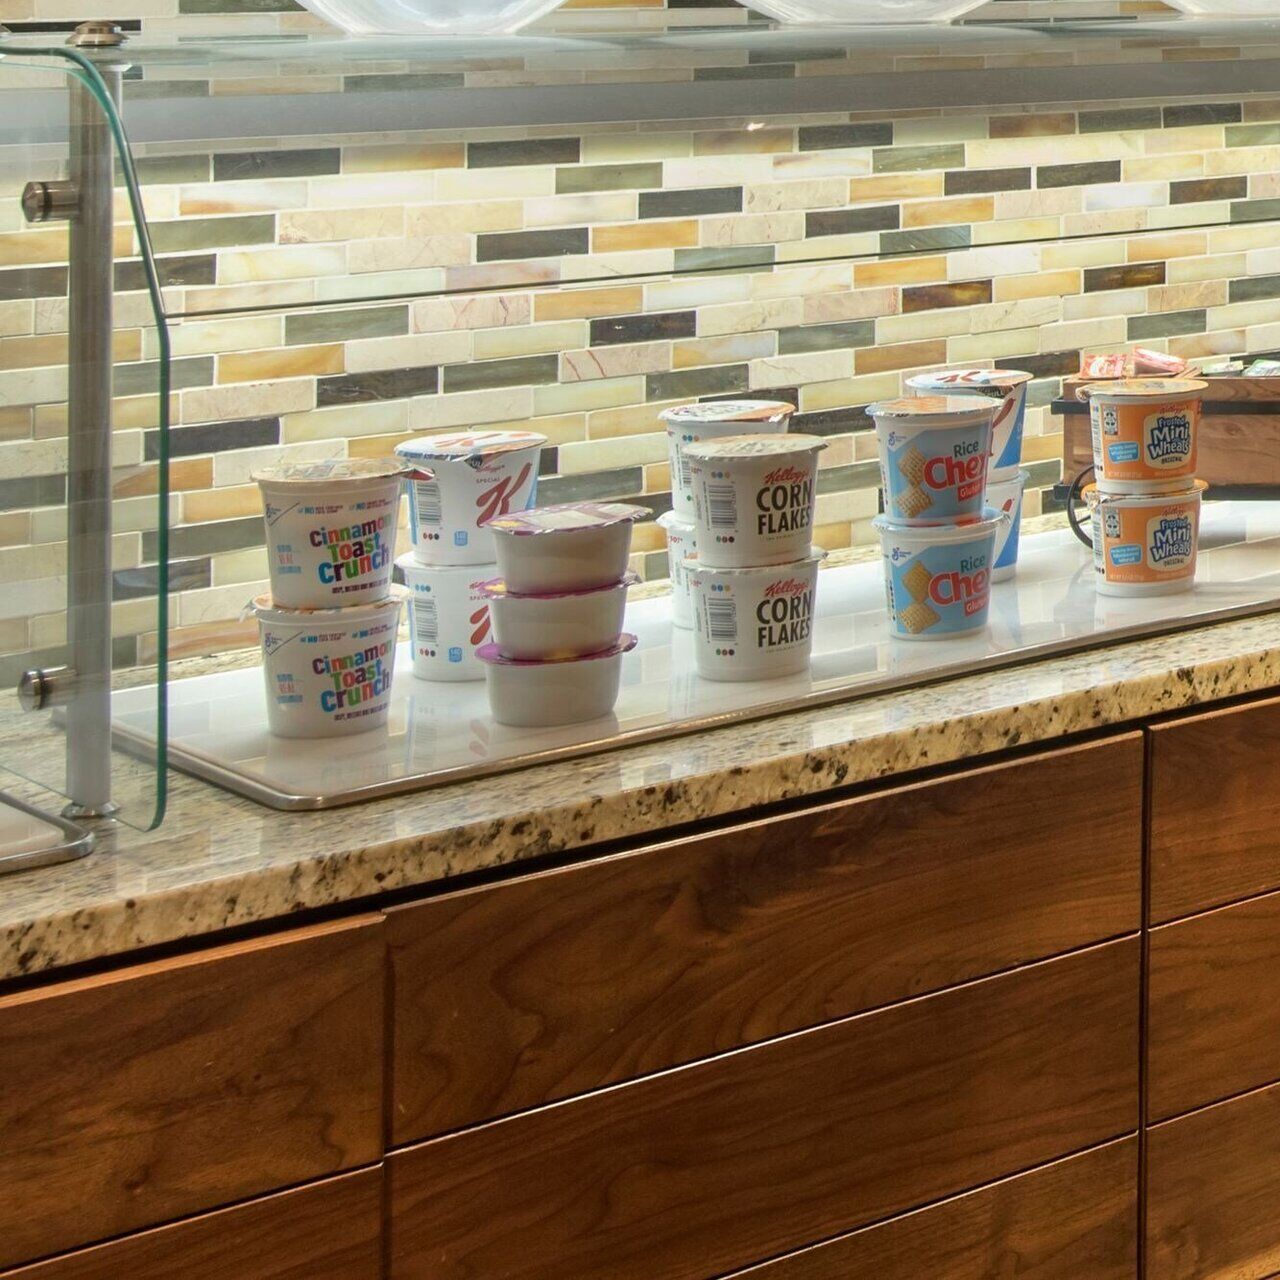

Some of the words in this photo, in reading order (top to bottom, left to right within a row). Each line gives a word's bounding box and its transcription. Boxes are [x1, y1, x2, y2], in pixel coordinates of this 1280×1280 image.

[953, 440, 979, 458] Rice
[1148, 440, 1190, 459] Wheats
[1152, 424, 1189, 445] Mini
[756, 478, 812, 513] CORN
[758, 506, 811, 535] FLAKES
[327, 531, 381, 562] Toast
[1152, 542, 1191, 562] Wheats
[1155, 527, 1191, 547] Mini
[318, 543, 389, 584] Crunch
[961, 555, 985, 573] Rice
[756, 590, 812, 625] CORN
[758, 617, 811, 648] FLAKES
[330, 657, 382, 690] Toast
[320, 668, 390, 713] Crunch
